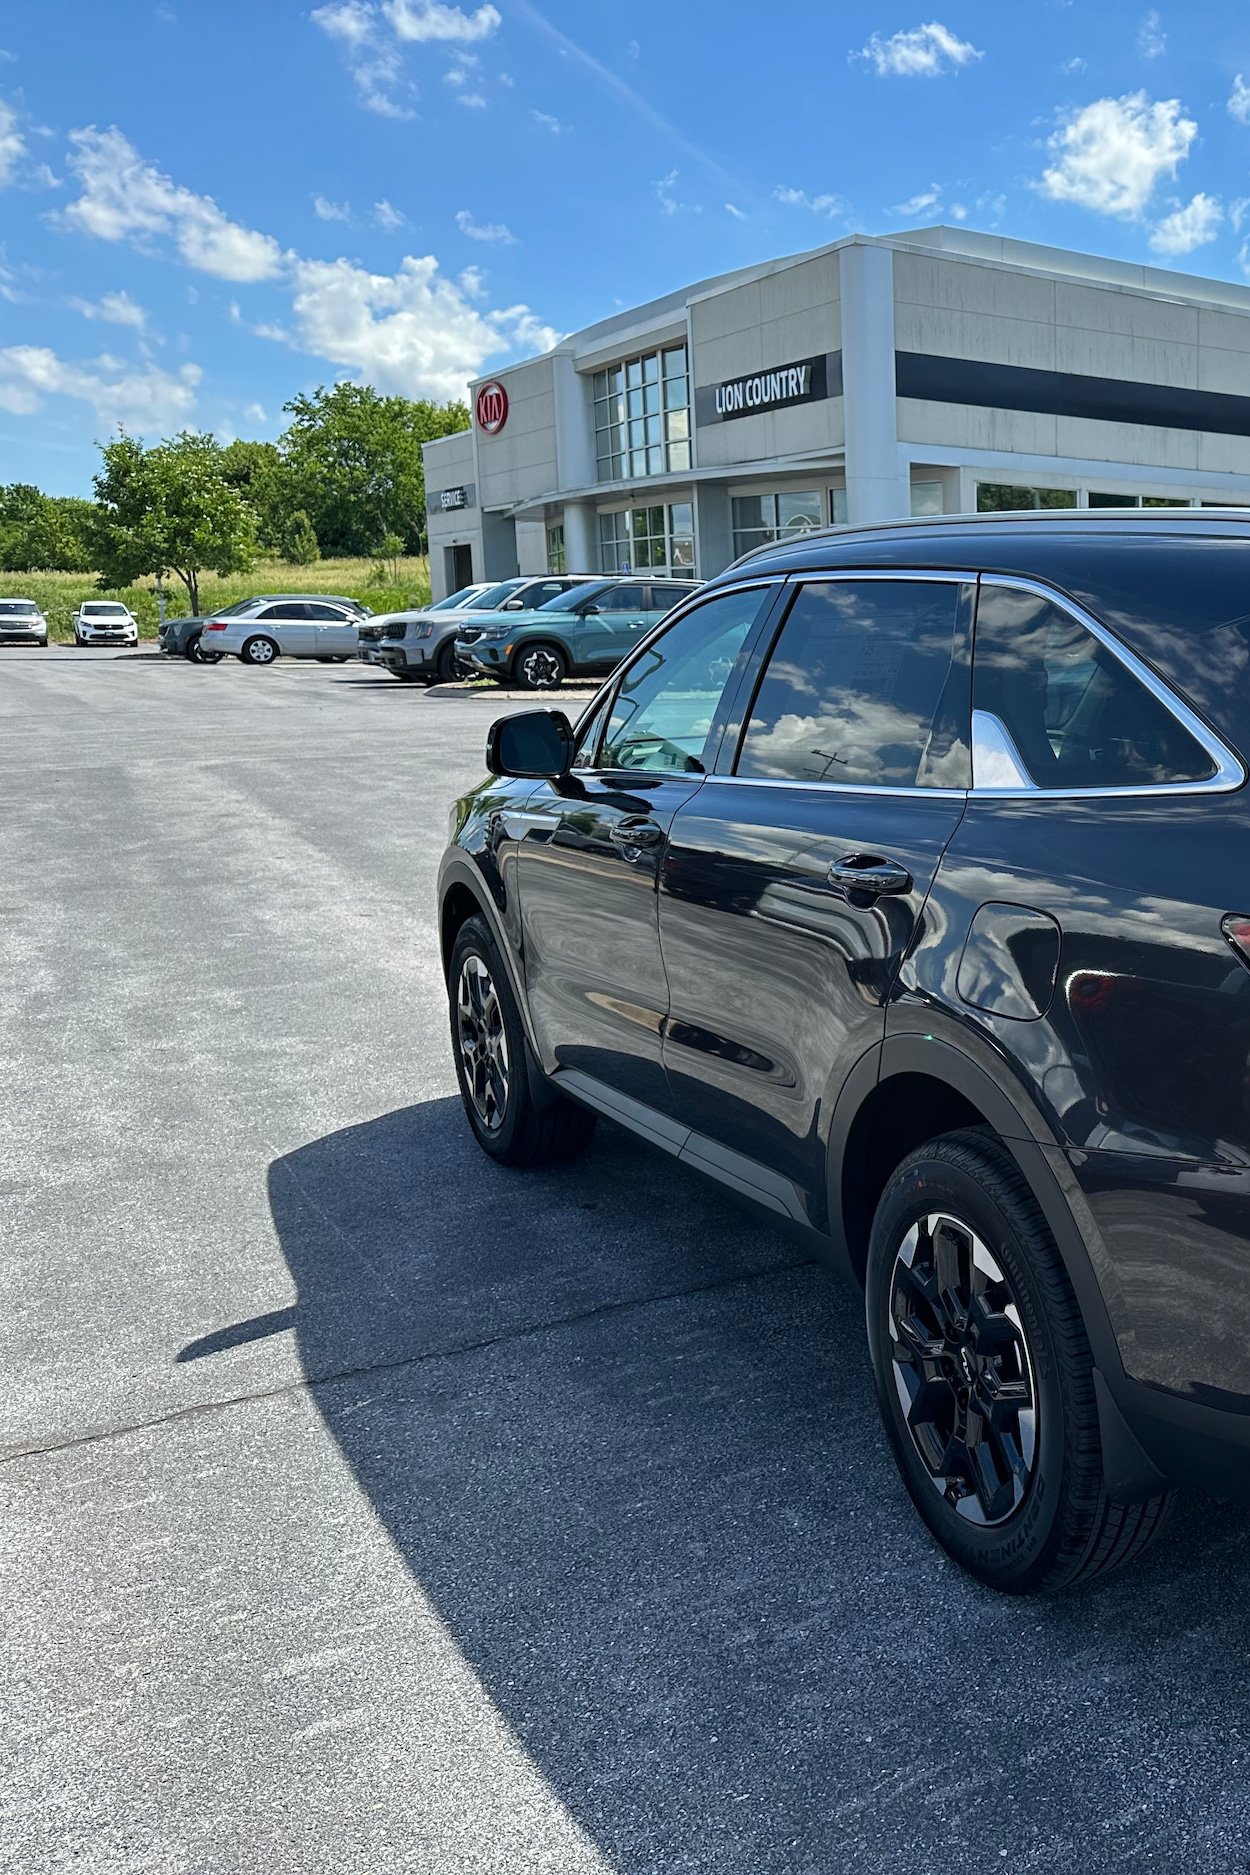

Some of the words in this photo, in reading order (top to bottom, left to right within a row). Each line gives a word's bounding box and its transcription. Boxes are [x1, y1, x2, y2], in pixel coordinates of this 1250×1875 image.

[478, 393, 500, 424] KIA
[715, 382, 743, 414] LION
[745, 365, 808, 407] COUNTRY
